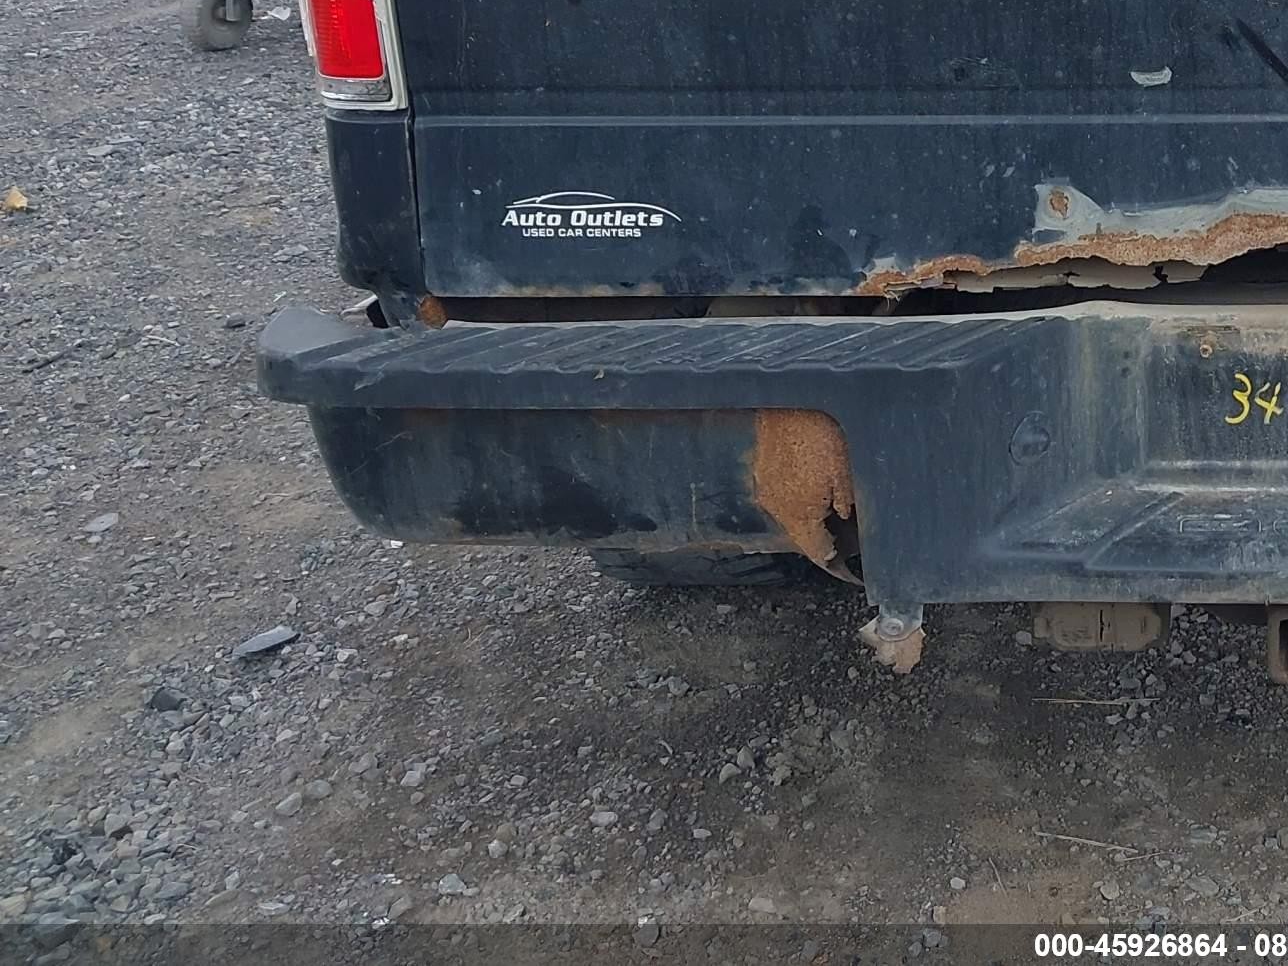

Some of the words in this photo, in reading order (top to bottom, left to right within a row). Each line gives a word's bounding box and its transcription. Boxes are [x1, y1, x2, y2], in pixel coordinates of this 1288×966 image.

[502, 209, 562, 227] Auto
[570, 209, 664, 227] Outlets
[522, 228, 555, 238] USED
[558, 228, 583, 238] CAR
[586, 228, 641, 238] CENTERS
